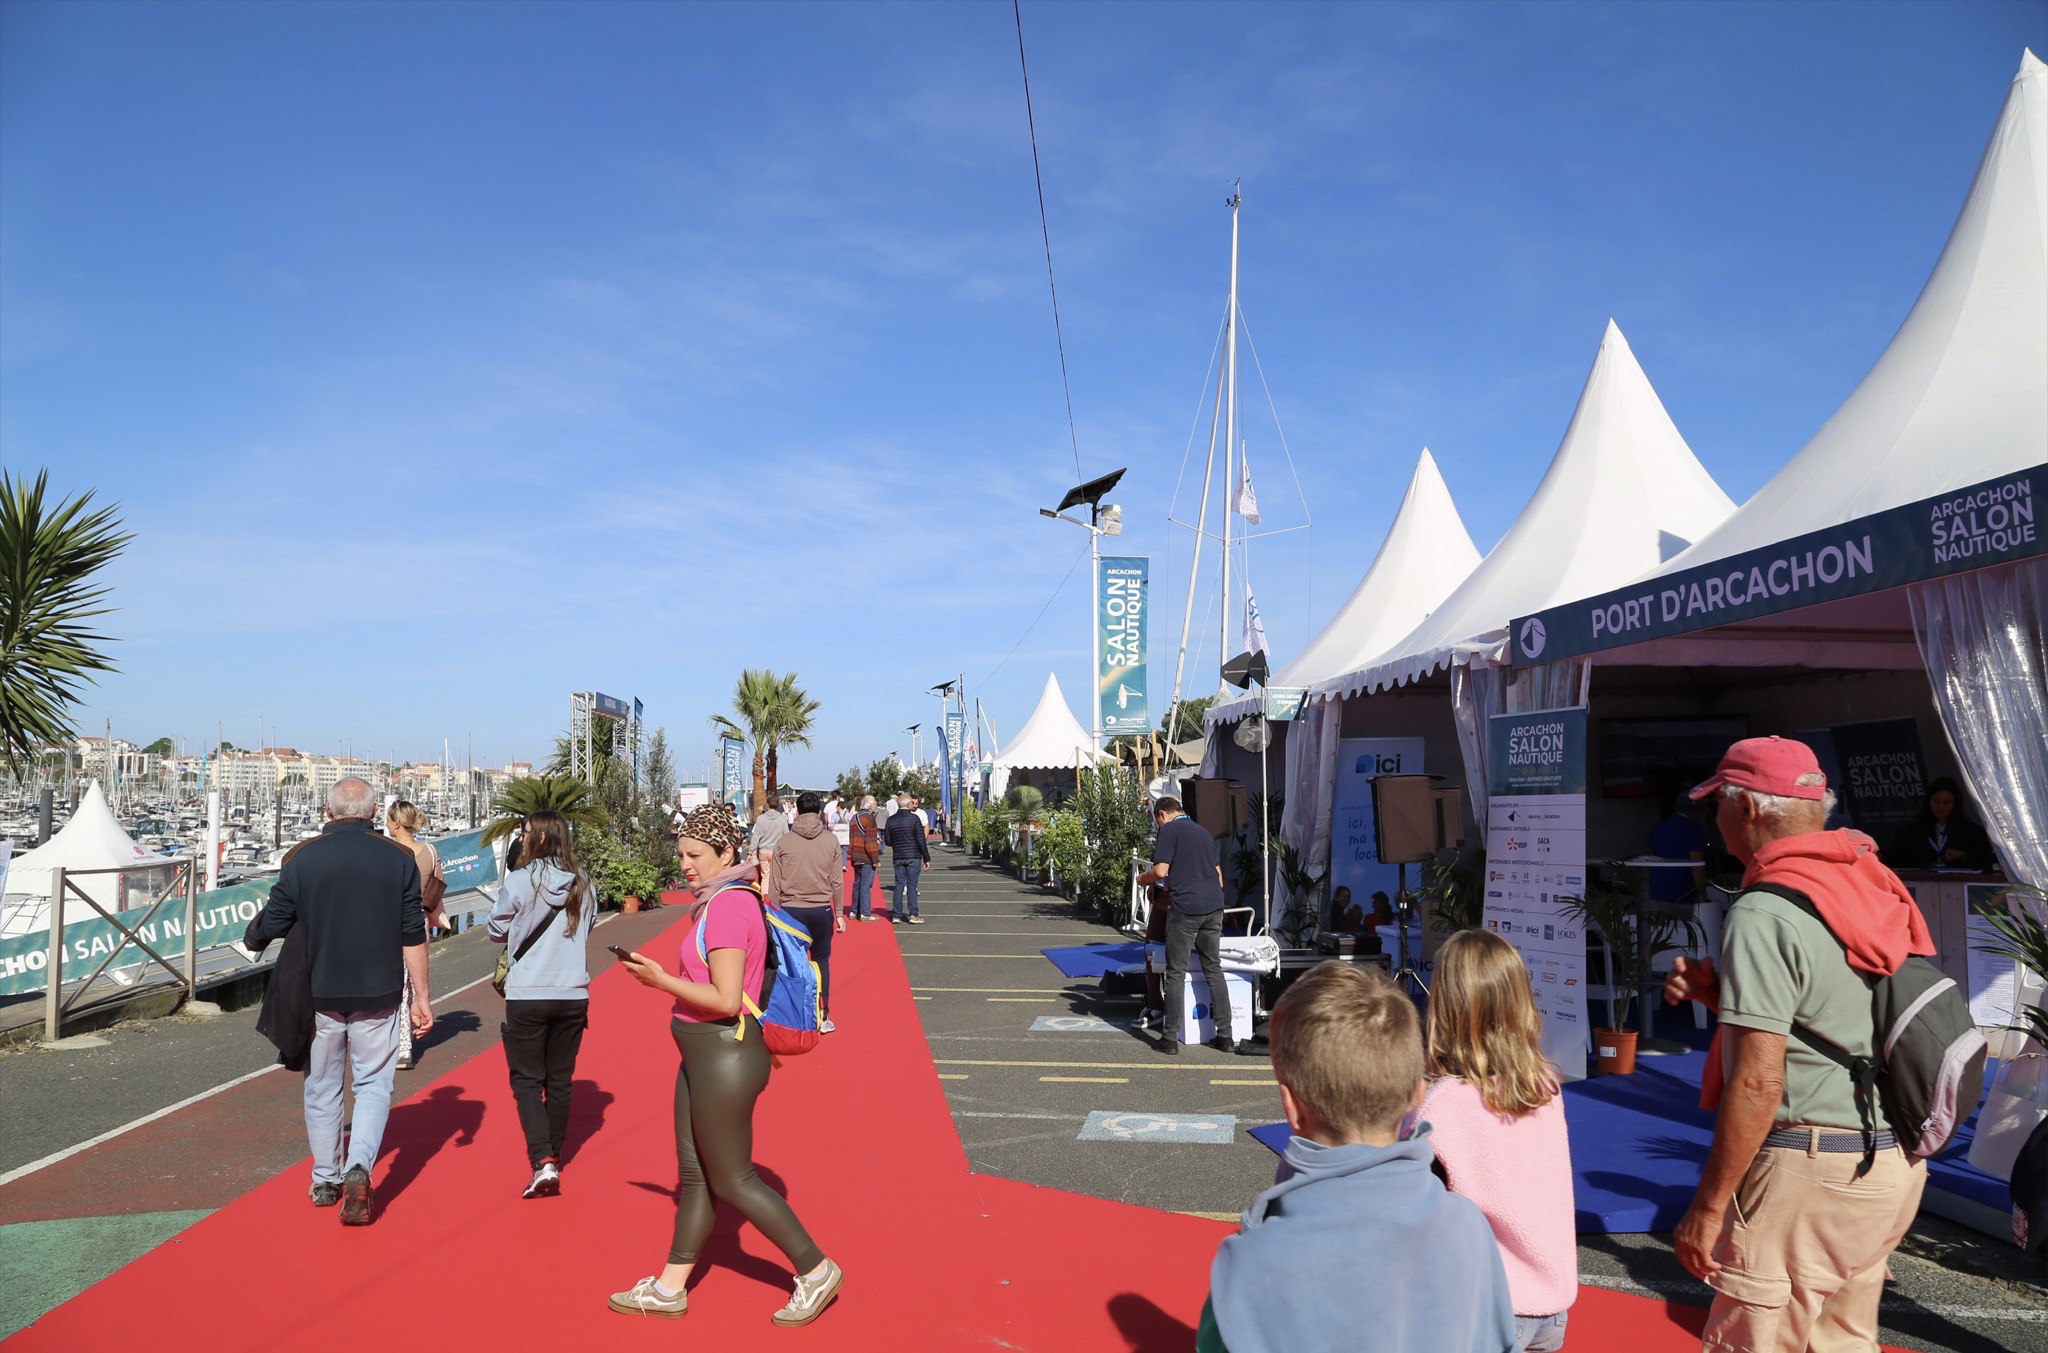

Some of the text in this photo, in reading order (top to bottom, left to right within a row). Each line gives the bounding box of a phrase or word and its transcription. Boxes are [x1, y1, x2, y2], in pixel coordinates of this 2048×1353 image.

[1930, 479, 2031, 521] ARCACHON
[1931, 496, 2034, 545] SALON
[1934, 523, 2036, 564] NAUTIQUE
[1591, 535, 1874, 639] PORT D'ARCACHON
[1107, 578, 1126, 666] SALON
[1126, 578, 1141, 666] NAUTIQUE
[948, 720, 956, 753] SALON
[1509, 722, 1564, 738] ARCACHON
[1509, 734, 1564, 754] SALON
[1375, 753, 1401, 774] ici
[1508, 751, 1563, 766] NAUTIQUE
[1847, 752, 1917, 768] ARCACHON
[726, 749, 736, 791] SALON
[1849, 764, 1922, 786] SALON
[1853, 783, 1926, 799] NAUTIQUE
[1537, 837, 1550, 845] SACA
[446, 855, 479, 867] Arcachon
